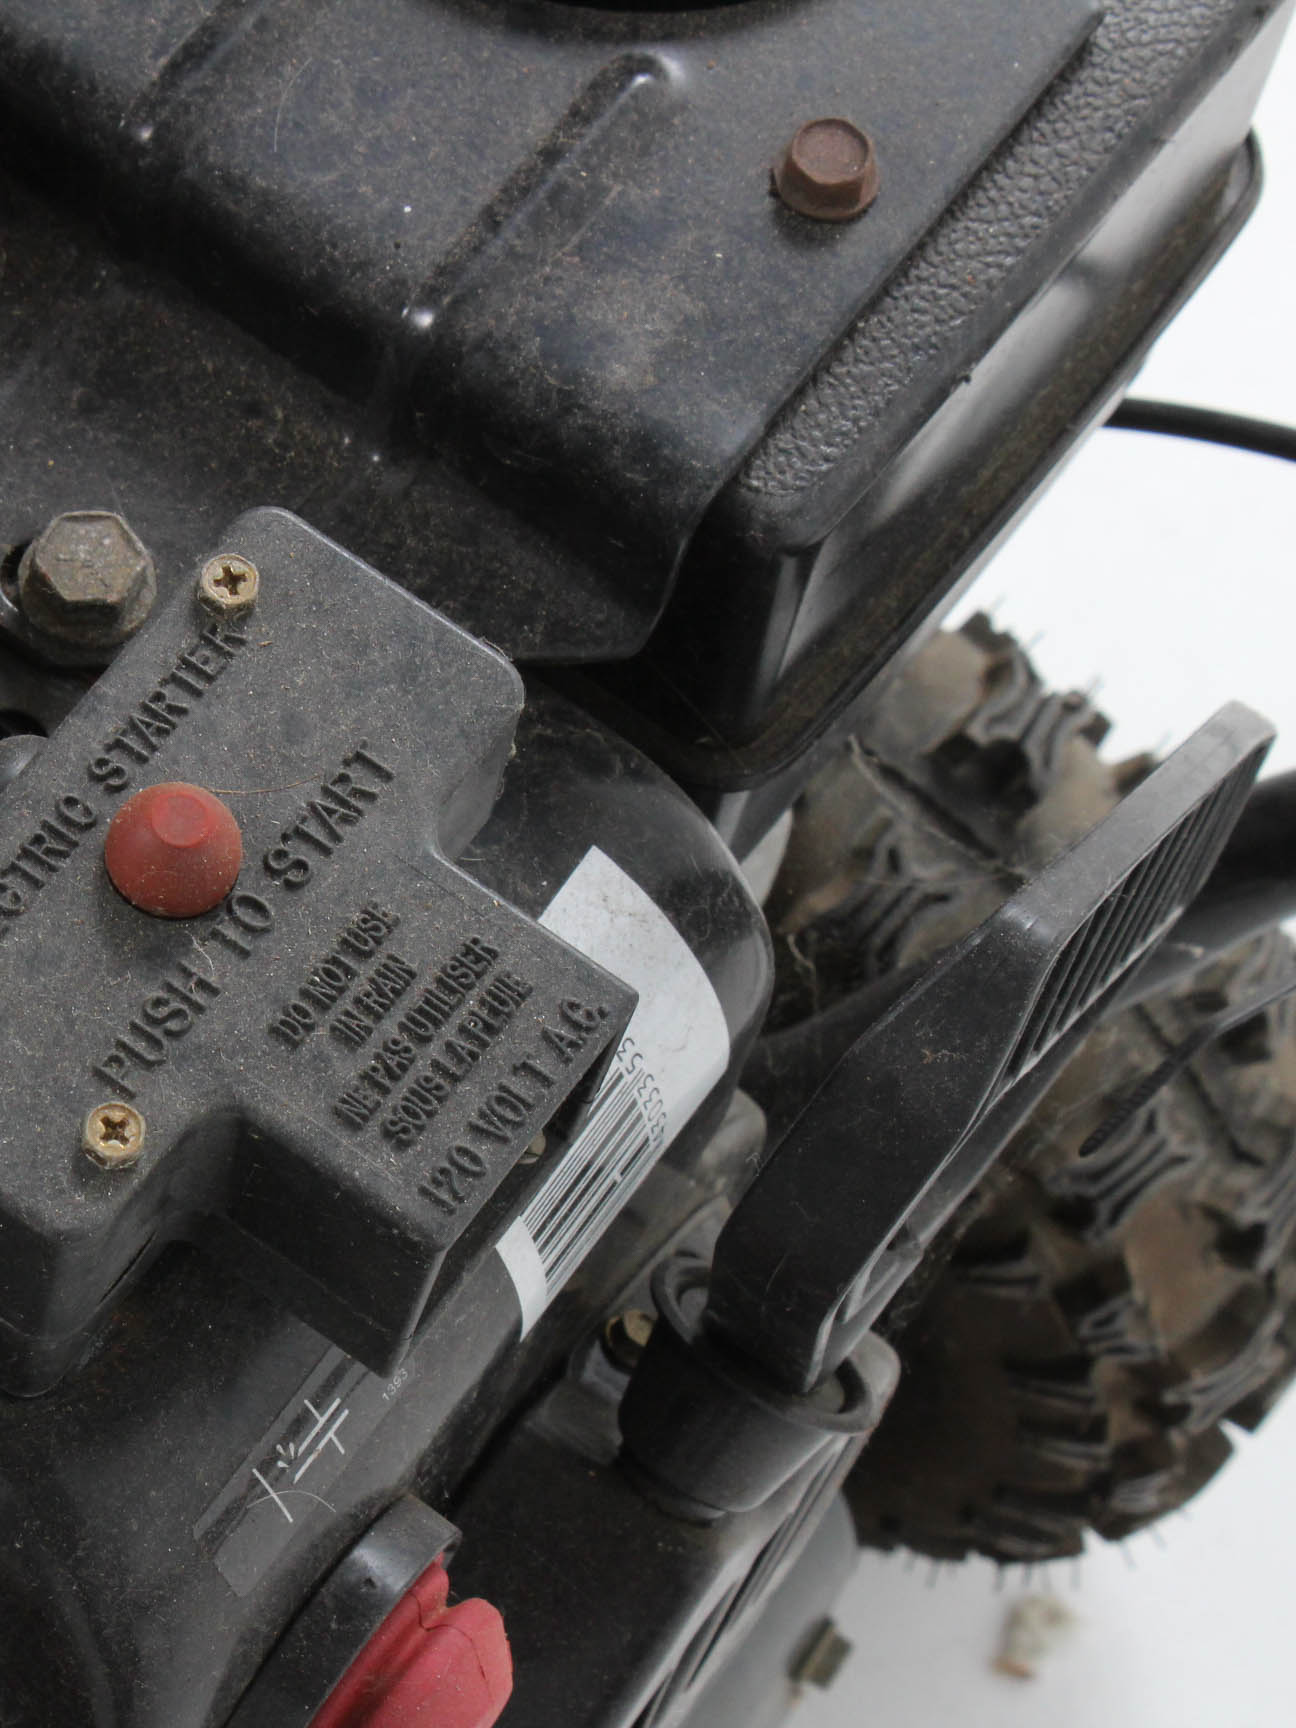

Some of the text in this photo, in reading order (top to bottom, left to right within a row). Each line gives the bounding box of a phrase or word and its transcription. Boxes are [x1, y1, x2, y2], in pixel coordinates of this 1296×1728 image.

[88, 622, 250, 794] STARTER
[92, 742, 396, 1100] PUSH TO START
[269, 901, 401, 1050] DO NOT USE
[330, 952, 418, 1050] IN RAIN
[333, 934, 501, 1130] NE PAS UTILISER
[381, 969, 534, 1148] SOUS LA PLUIE
[418, 1143, 488, 1215] 120
[468, 1050, 559, 1143] VOLT
